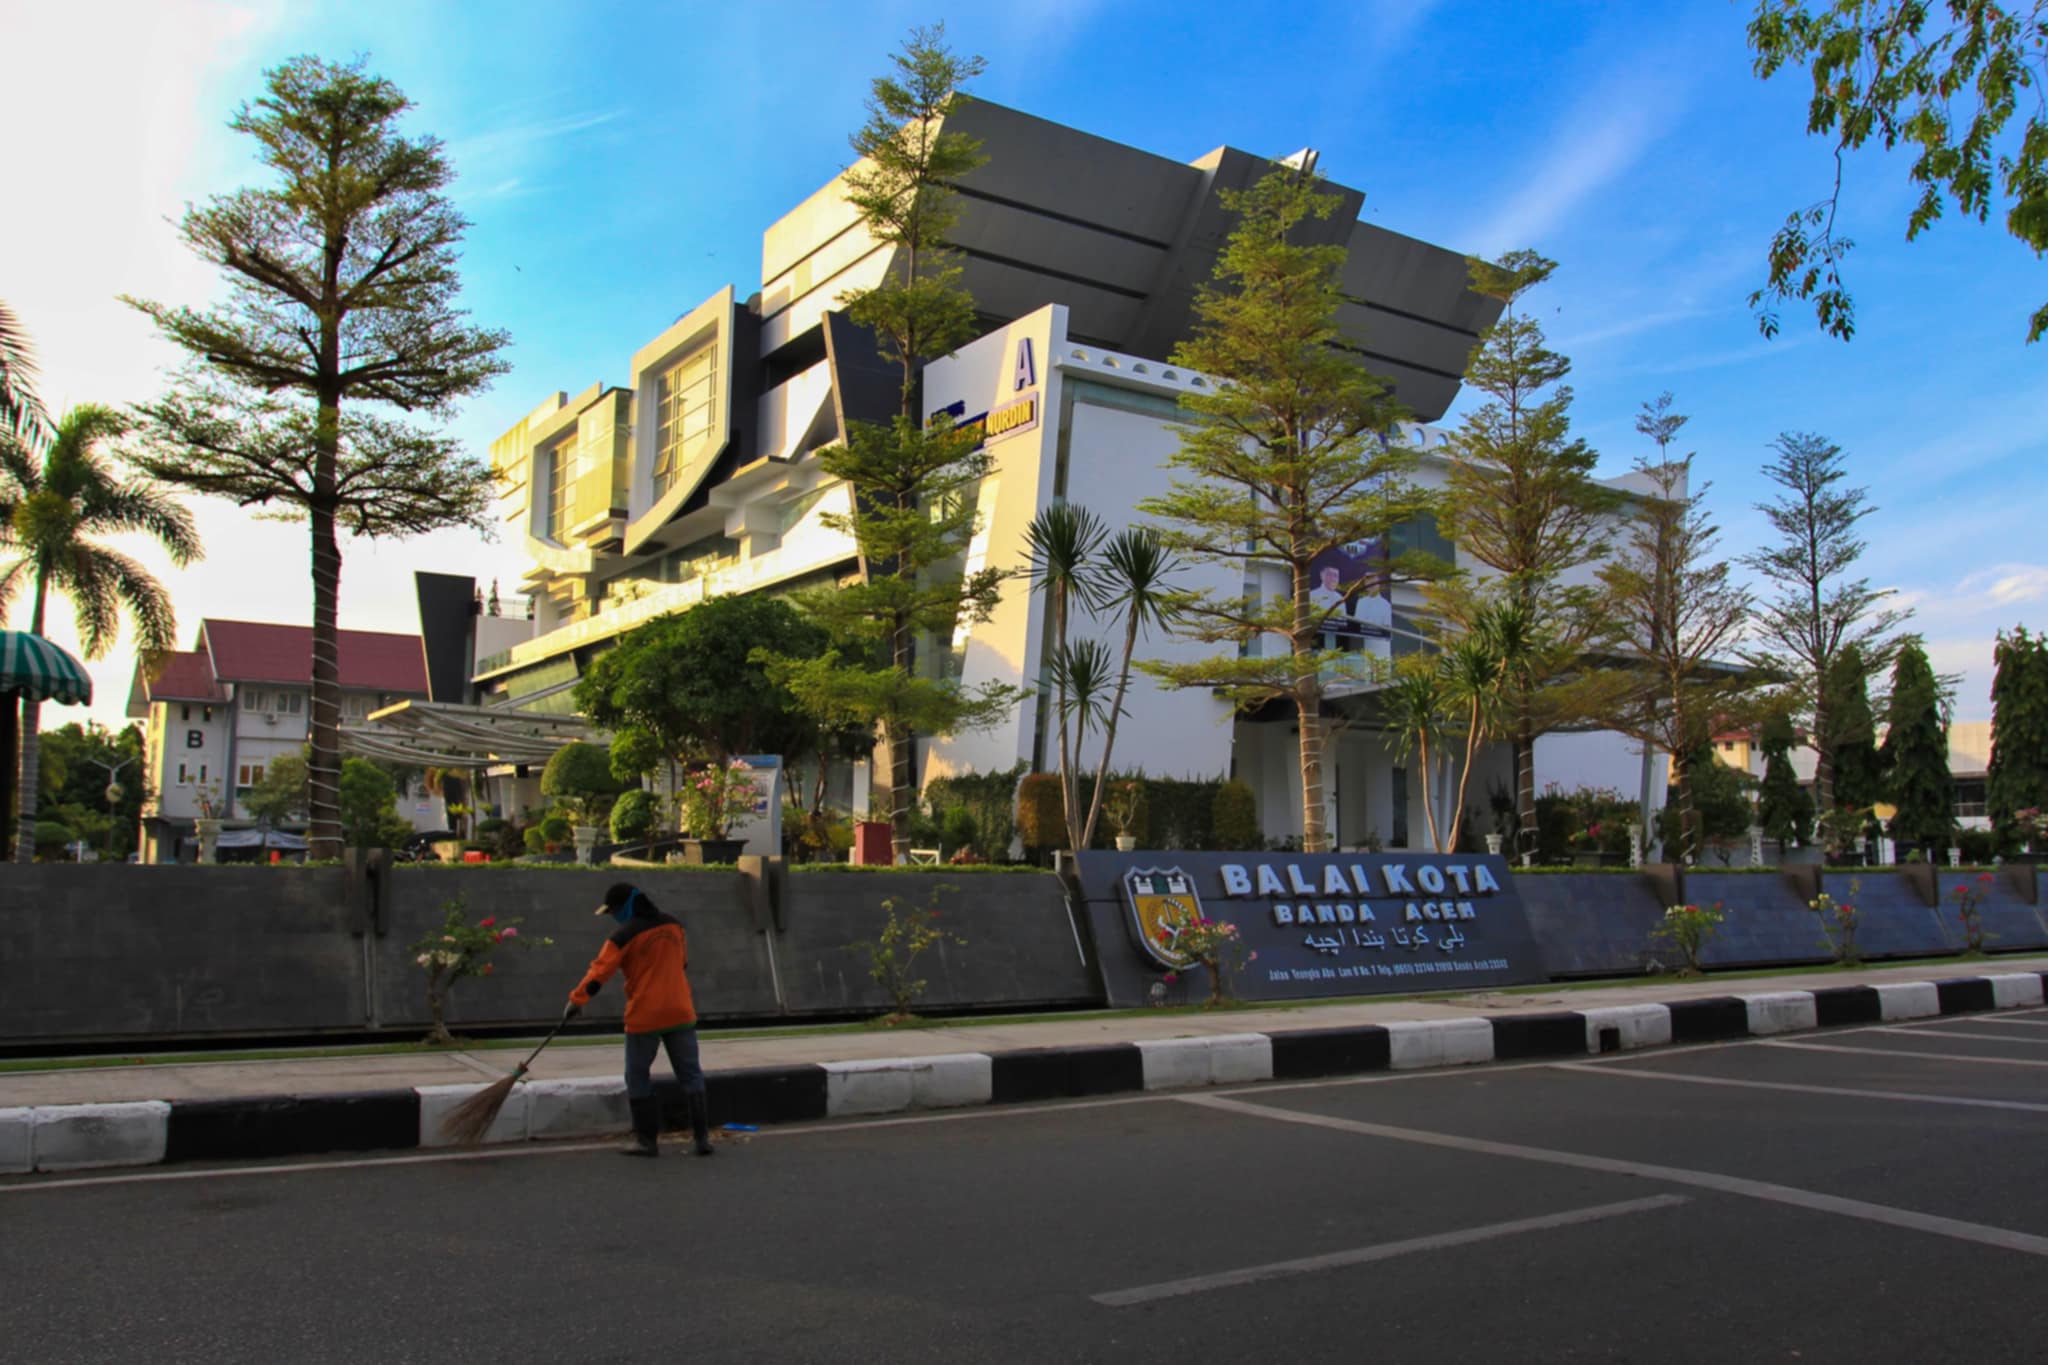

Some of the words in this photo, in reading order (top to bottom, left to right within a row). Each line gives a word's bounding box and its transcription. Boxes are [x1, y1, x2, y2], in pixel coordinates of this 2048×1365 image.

[1014, 337, 1036, 392] A
[985, 400, 1034, 437] NURDIN
[187, 729, 204, 749] B
[1220, 863, 1370, 896] BALAI
[1381, 863, 1500, 894] KOTA
[1273, 903, 1376, 925] BANDA
[1405, 901, 1476, 921] ACEH
